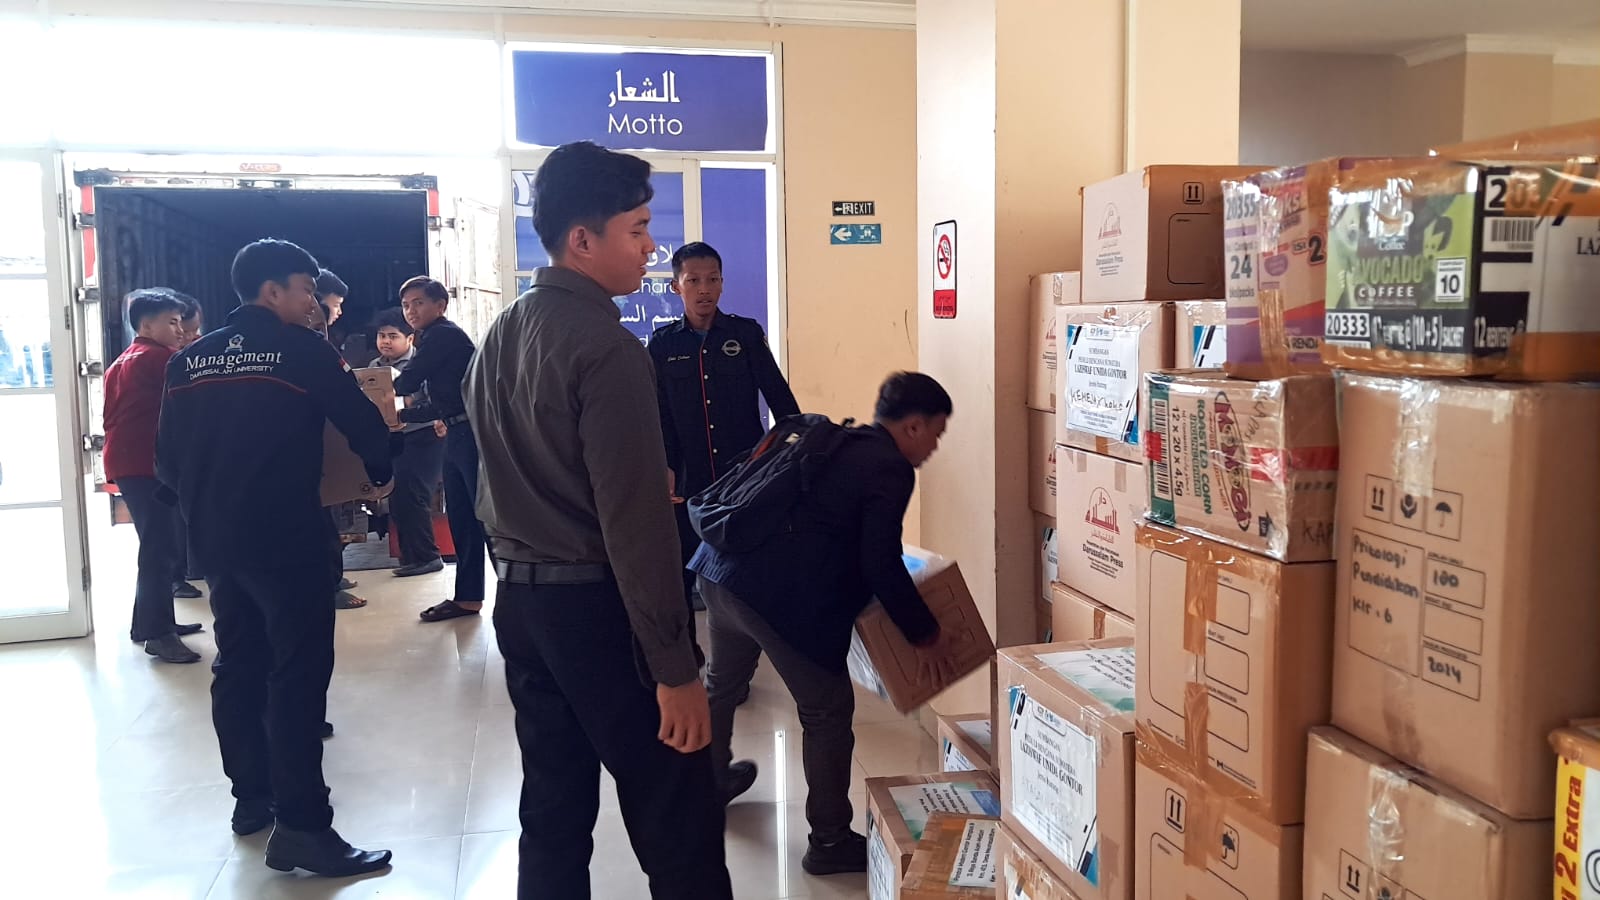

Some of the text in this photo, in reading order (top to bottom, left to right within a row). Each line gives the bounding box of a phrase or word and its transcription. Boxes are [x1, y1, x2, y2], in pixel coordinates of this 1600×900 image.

[608, 69, 680, 107] الشعار
[608, 113, 683, 135] Motto
[854, 202, 873, 215] EXIT
[1230, 254, 1253, 280] 24
[1358, 285, 1415, 299] COFFEE
[1440, 274, 1461, 294] 10
[1326, 313, 1369, 337] 20333
[185, 351, 283, 371] Management
[233, 365, 274, 373] UNIVERSITY
[1172, 406, 1180, 420] 12
[1173, 437, 1181, 453] 20
[1201, 473, 1213, 515] CORN
[1059, 769, 1084, 797] GONTOR
[1565, 776, 1583, 853] Extra
[1555, 852, 1578, 887] 2
